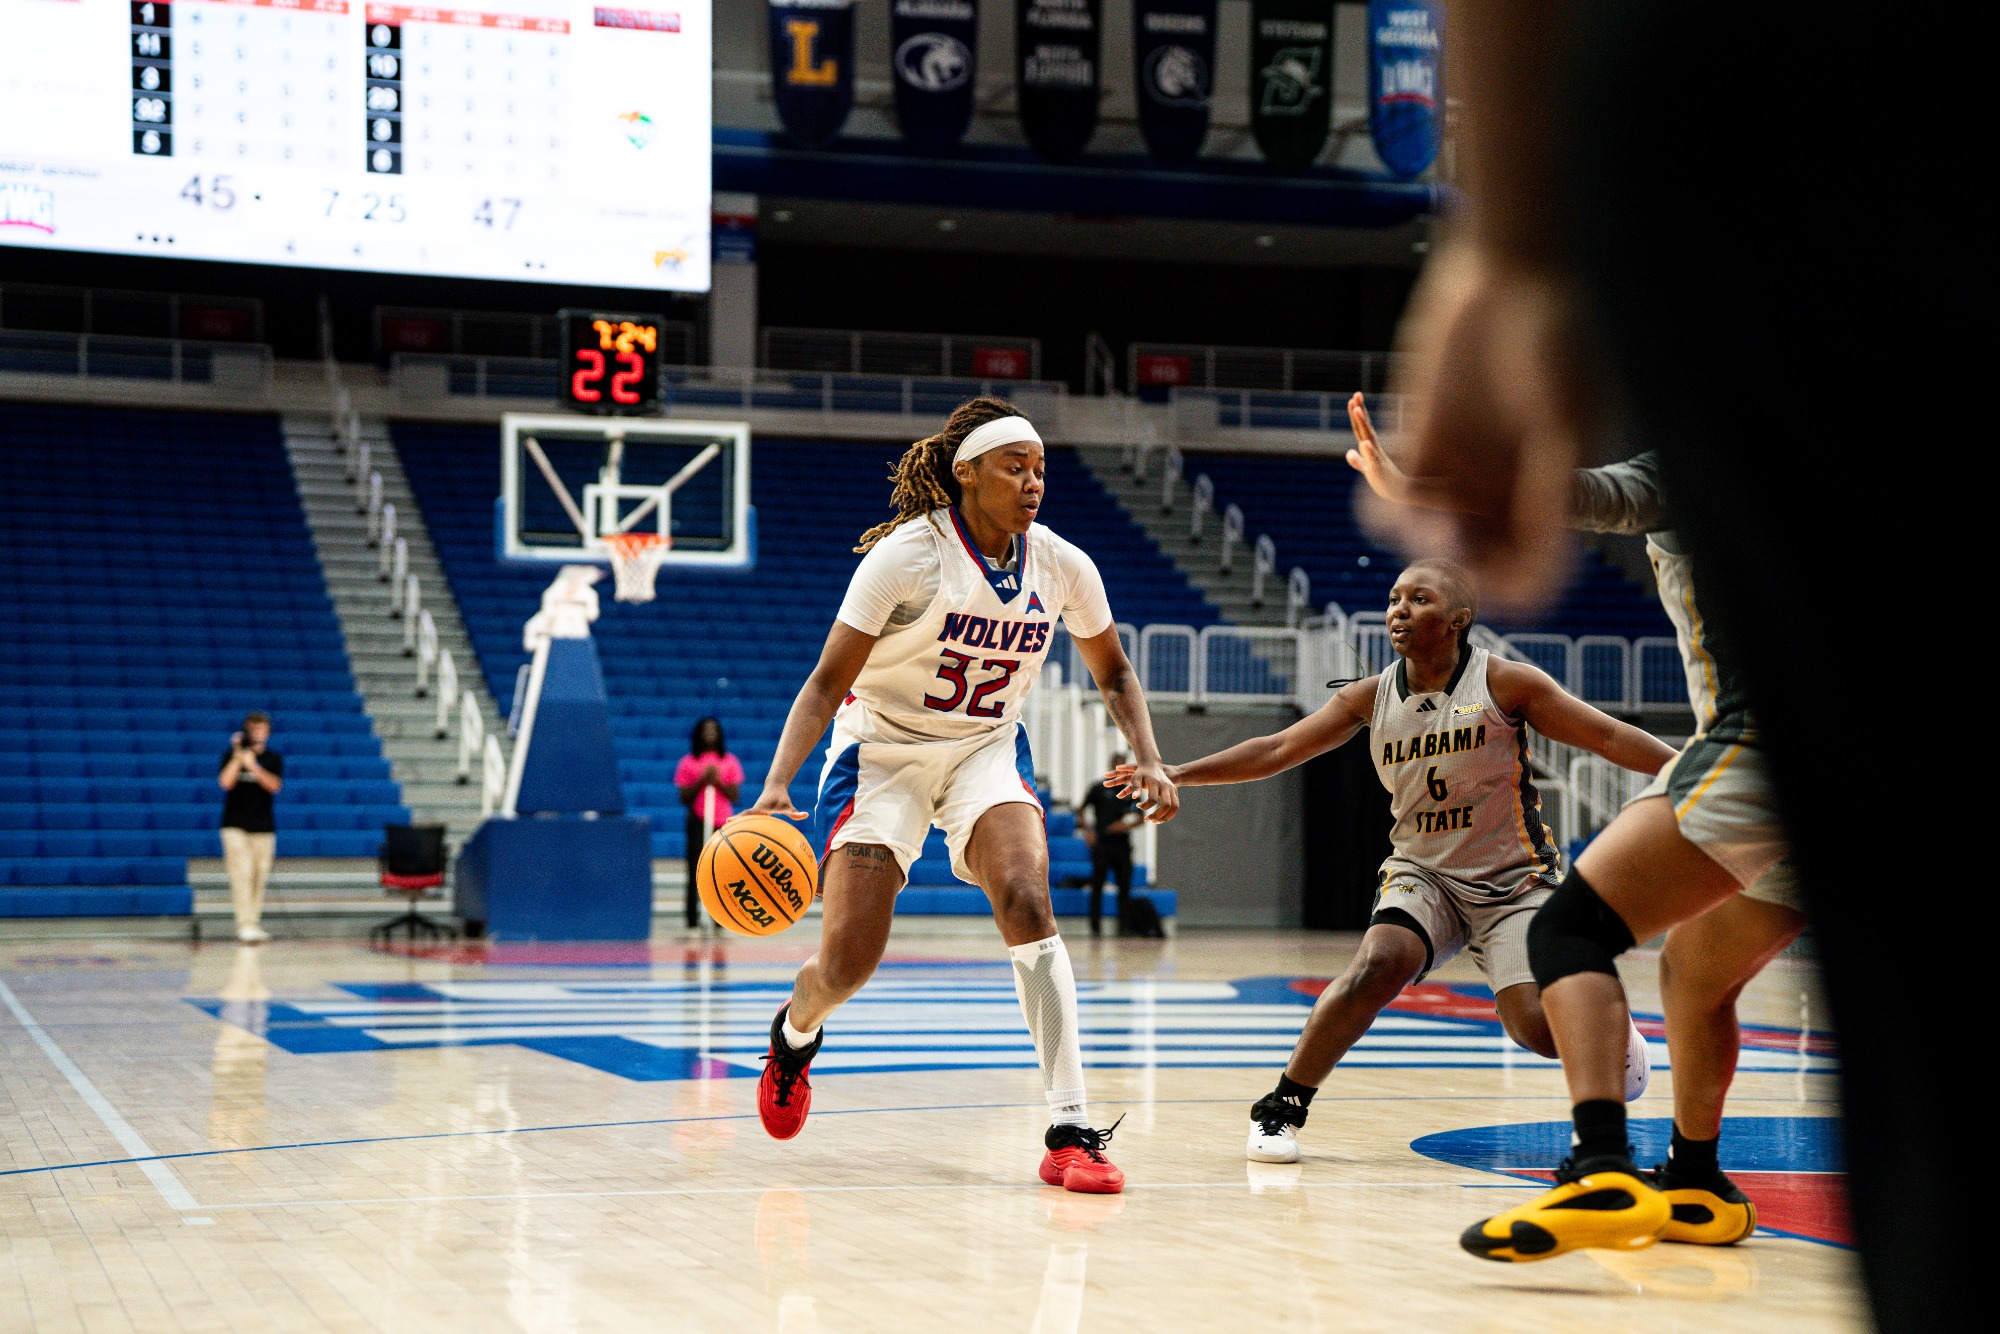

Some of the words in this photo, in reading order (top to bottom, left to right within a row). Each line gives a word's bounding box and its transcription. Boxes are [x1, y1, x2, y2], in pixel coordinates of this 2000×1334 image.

[786, 20, 838, 86] L
[179, 174, 236, 210] 45
[473, 198, 522, 230] 47
[592, 320, 657, 353] 7:24
[572, 349, 644, 405] 22
[936, 612, 1050, 653] WOLVES
[924, 647, 1021, 718] 32
[1382, 724, 1486, 766] ALABAMA
[1426, 764, 1449, 802] 6
[1416, 805, 1474, 833] STATE
[751, 842, 804, 914] Wilson
[728, 879, 778, 928] NCAA
